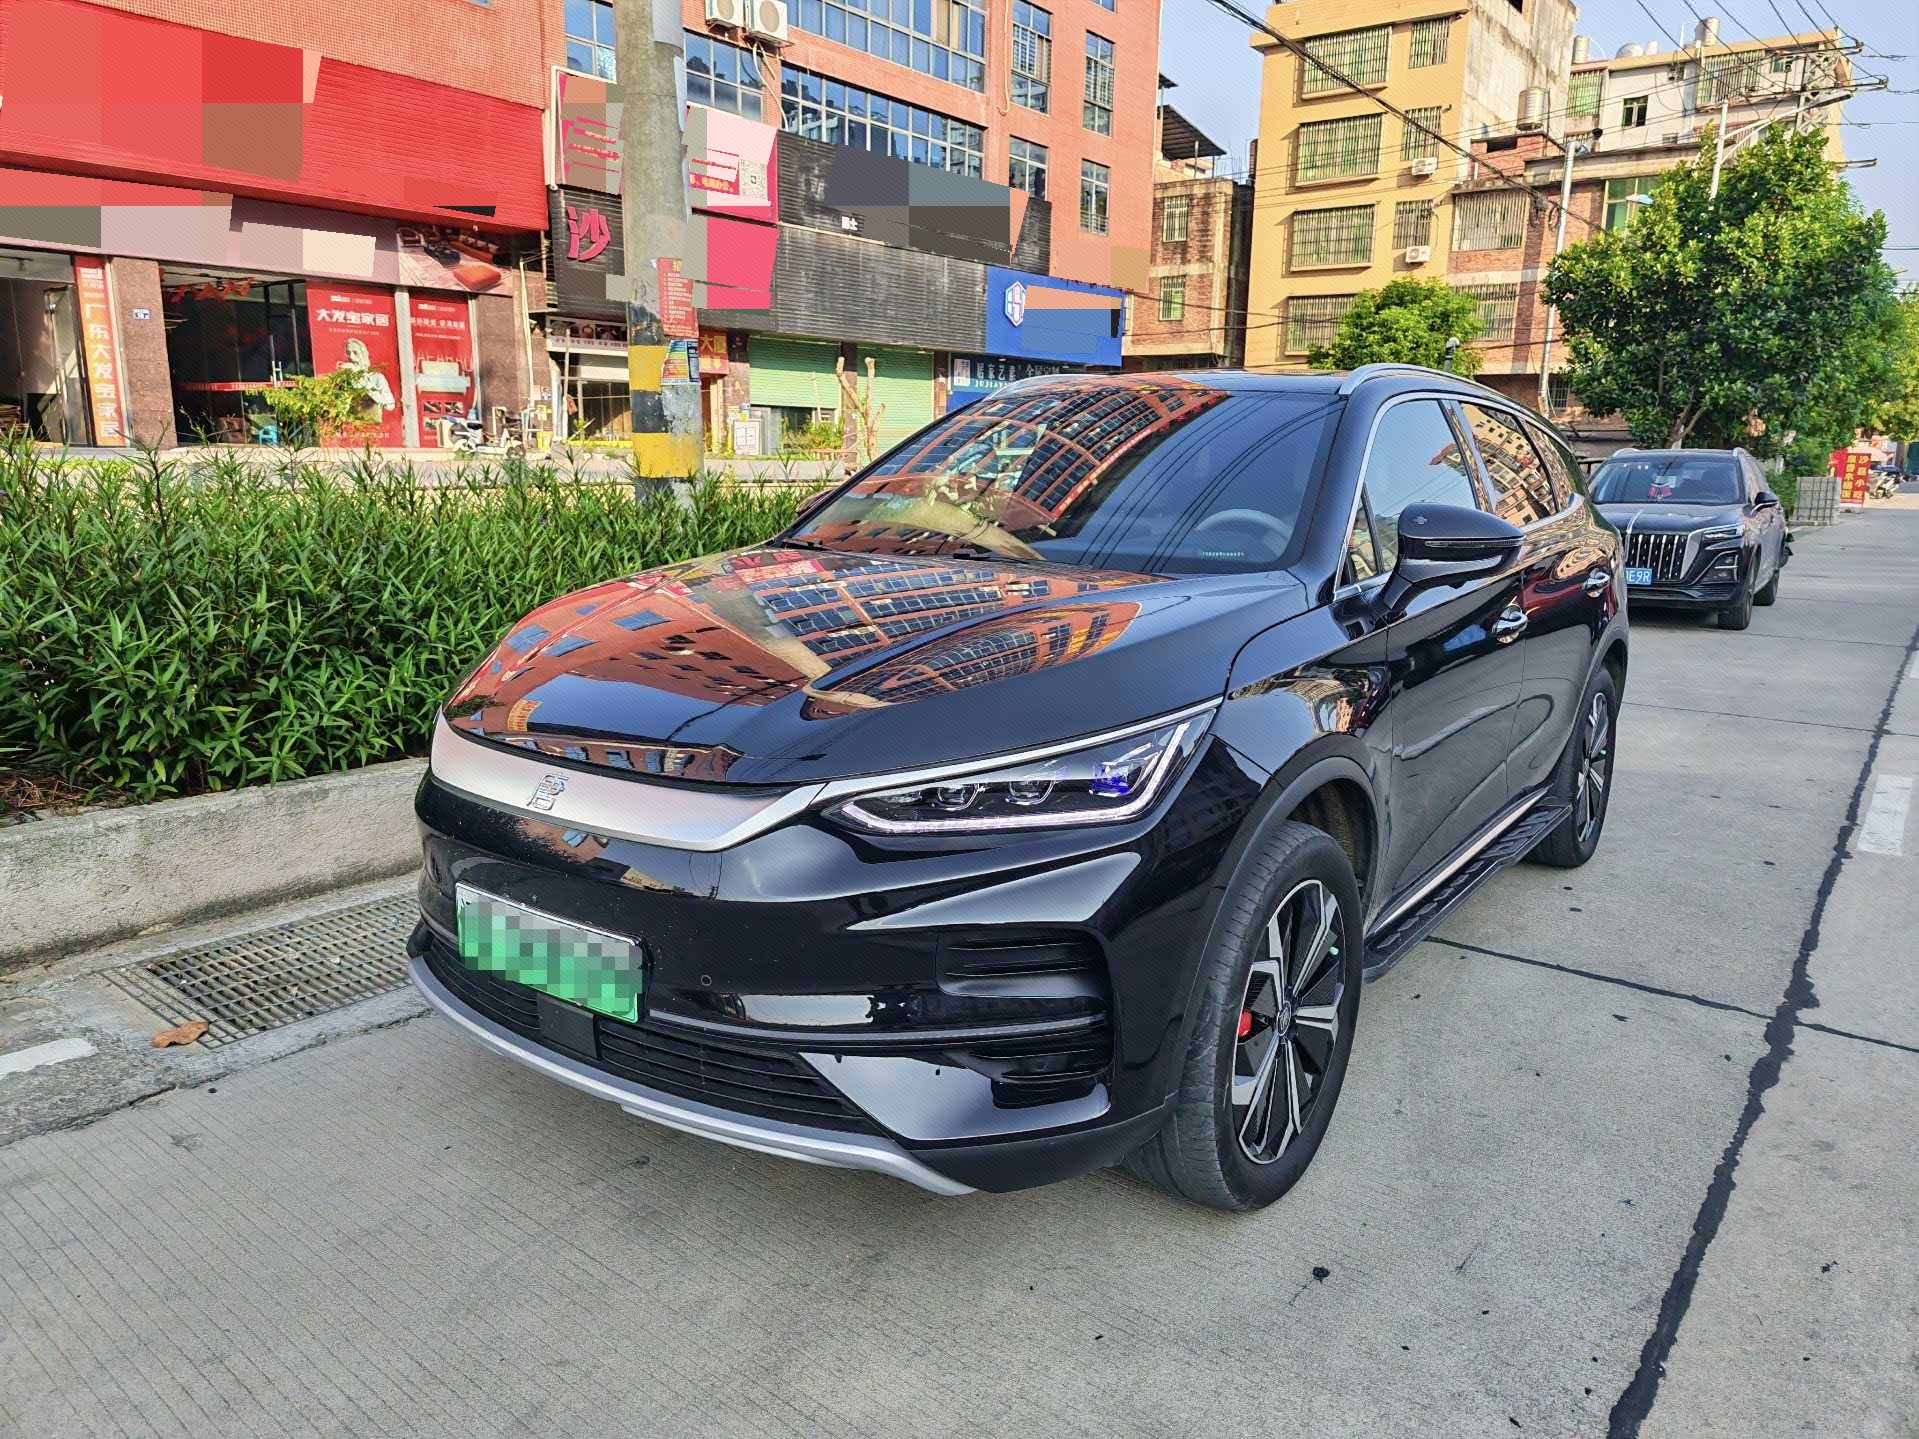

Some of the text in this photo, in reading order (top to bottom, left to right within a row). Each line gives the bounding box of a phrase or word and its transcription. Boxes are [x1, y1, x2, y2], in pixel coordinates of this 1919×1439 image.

[315, 308, 390, 327] 大发宝家居
[84, 303, 121, 438] 广东大发宝家居
